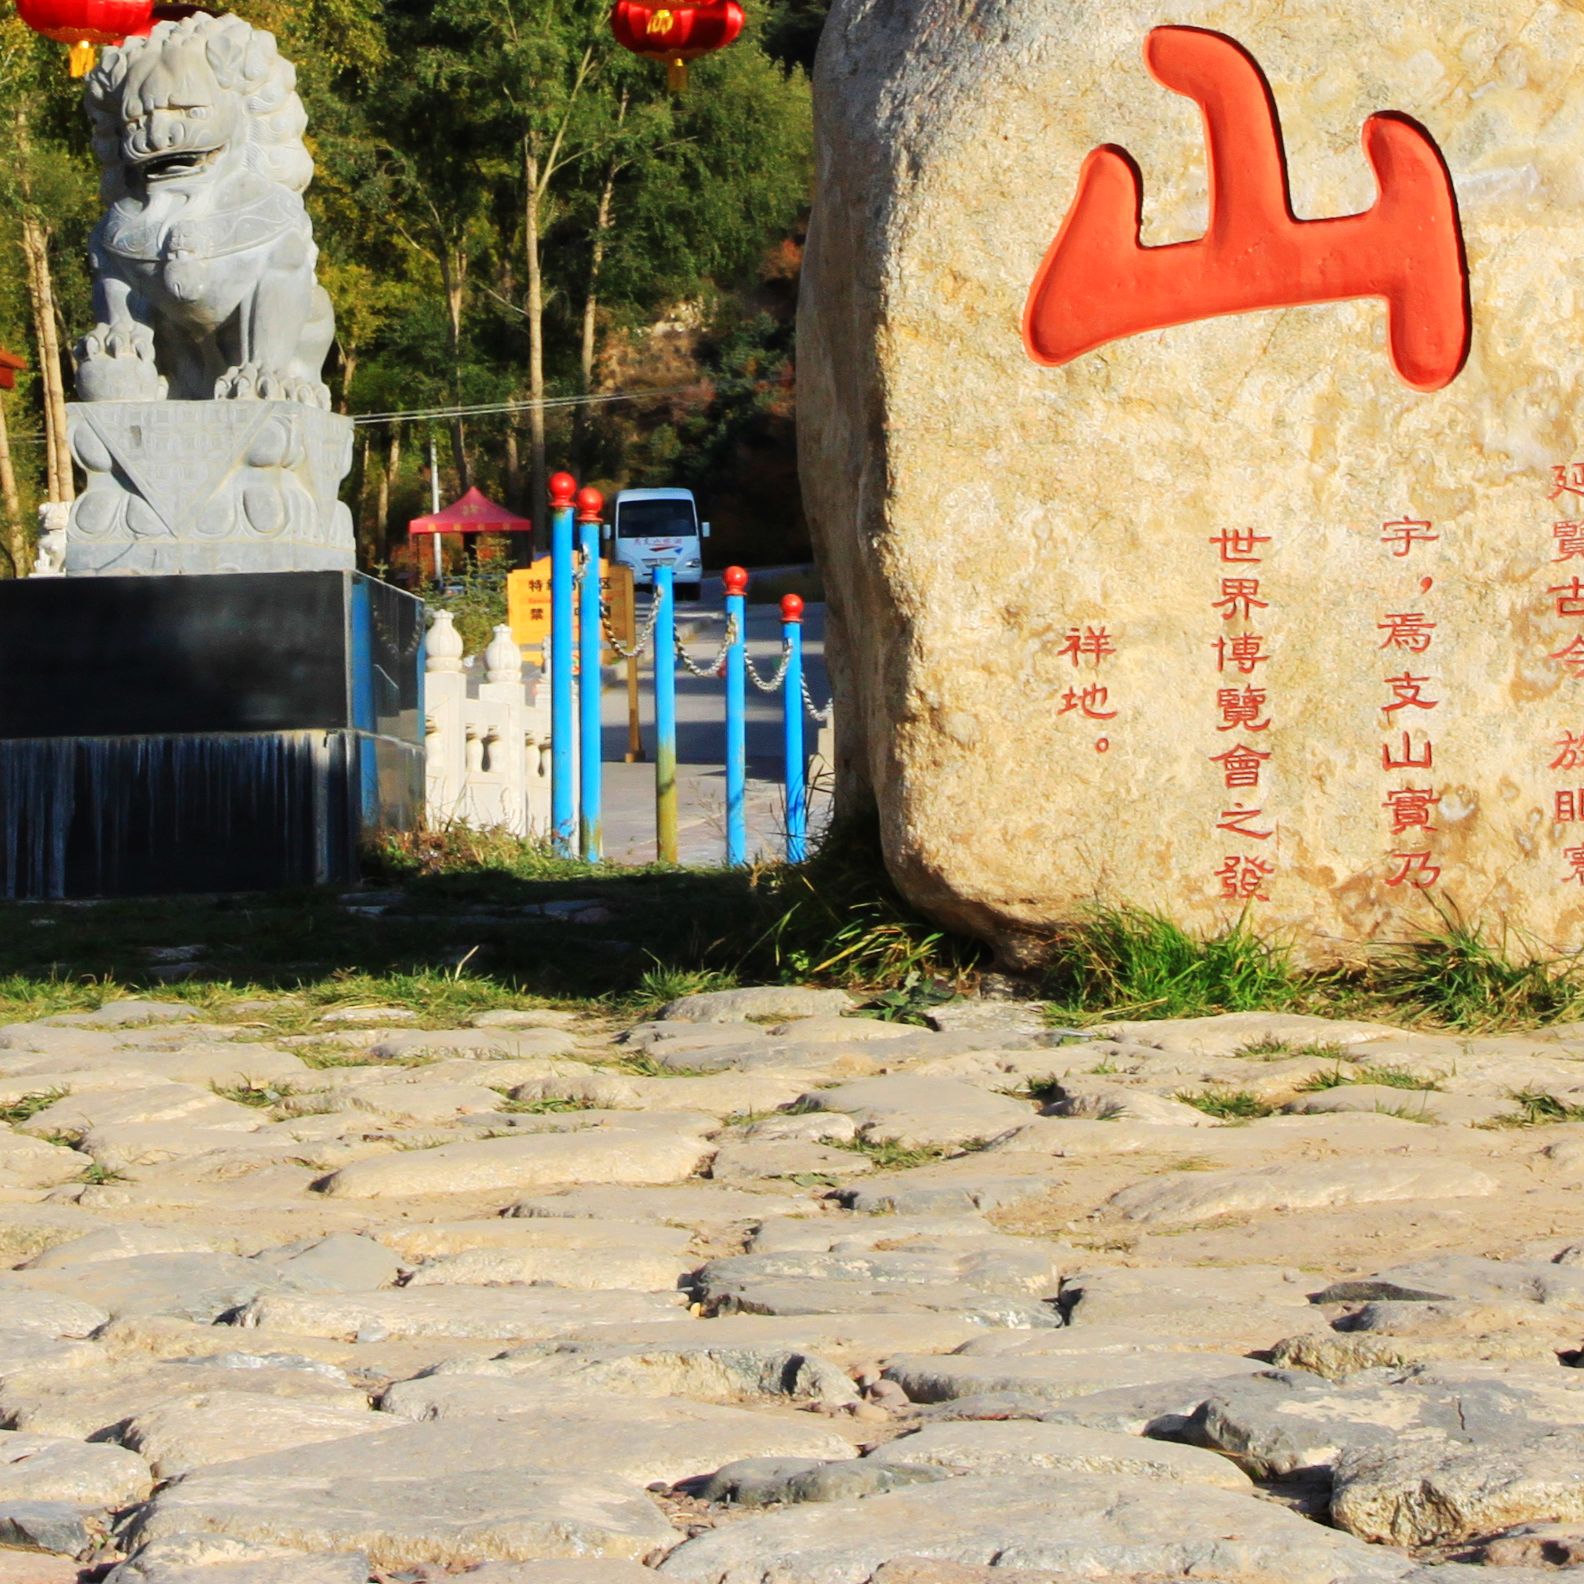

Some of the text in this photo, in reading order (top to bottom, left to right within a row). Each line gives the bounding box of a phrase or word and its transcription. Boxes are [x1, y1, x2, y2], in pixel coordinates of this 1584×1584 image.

[1208, 526, 1275, 904] 世界博覽會之發
[1376, 515, 1442, 891] 宇，焉支山實乃
